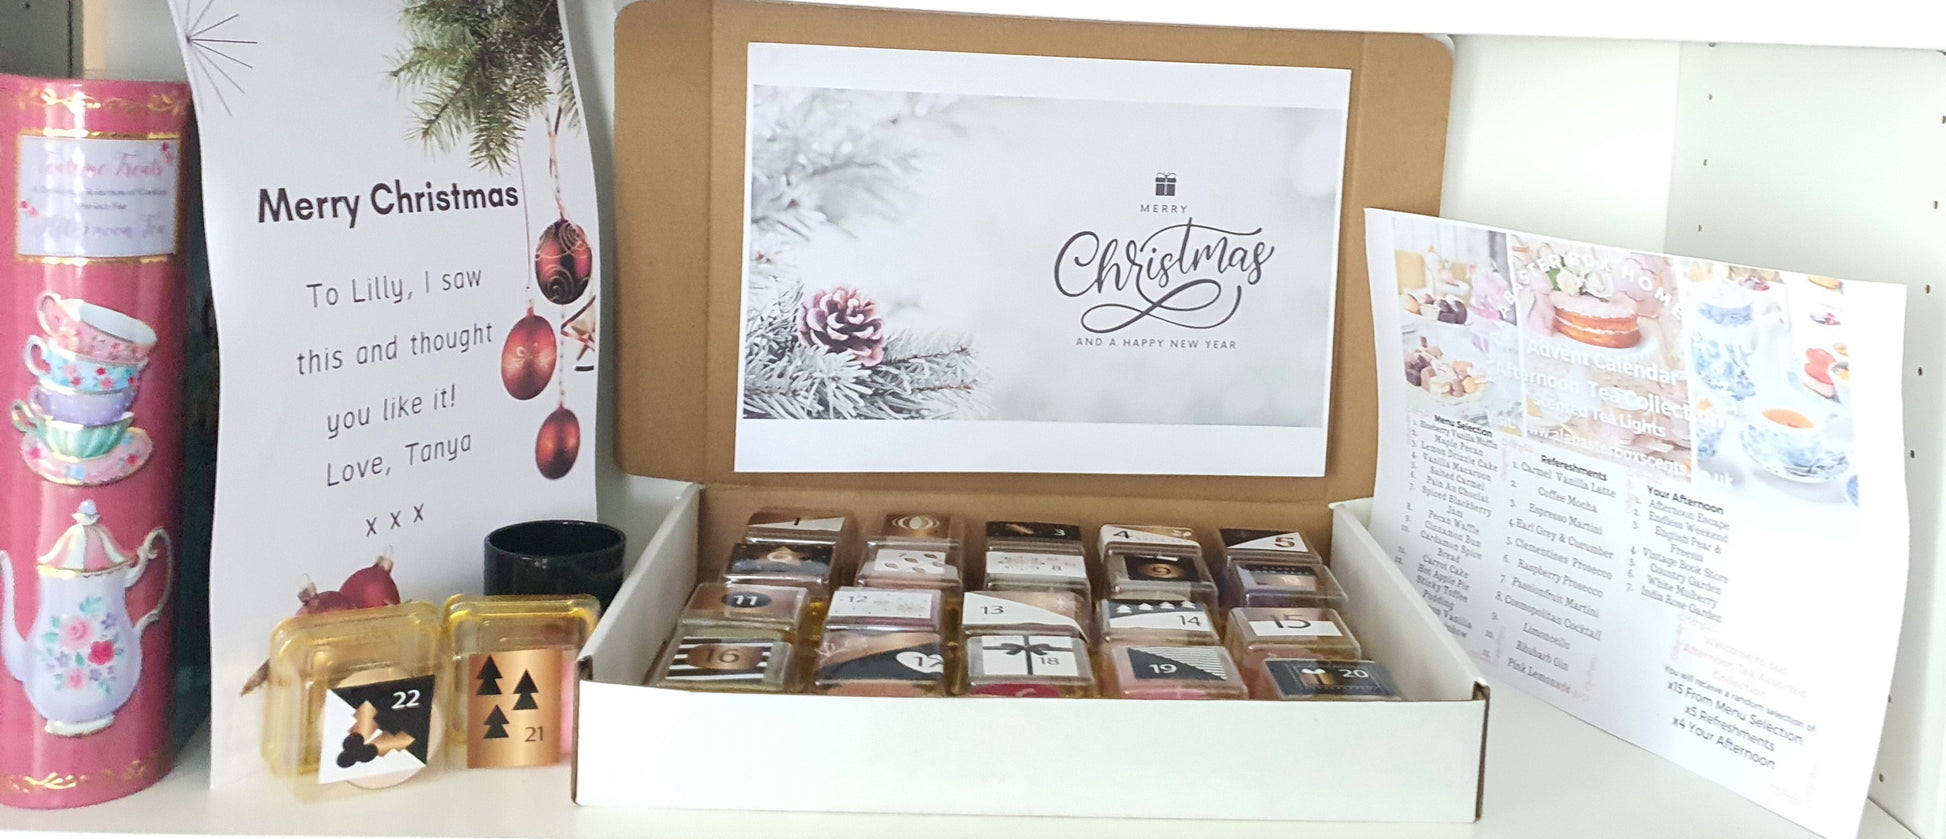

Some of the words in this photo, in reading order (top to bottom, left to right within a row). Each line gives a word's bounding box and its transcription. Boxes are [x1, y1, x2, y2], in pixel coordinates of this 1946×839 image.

[40, 152, 106, 176] Teatme
[258, 188, 360, 229] Merry
[370, 179, 519, 215] Christmas
[1140, 203, 1188, 214] MERRY
[305, 283, 339, 308] To
[352, 275, 413, 304] Lilly,
[424, 271, 430, 294] I
[441, 269, 483, 290] saw
[1054, 217, 1275, 333] Christmas
[1621, 265, 1684, 321] HOME
[297, 349, 344, 375] this
[356, 335, 398, 365] and
[410, 322, 493, 356] thought
[1075, 338, 1103, 347] AND
[1109, 338, 1117, 347] A
[1123, 338, 1164, 348] HAPPY
[1170, 339, 1199, 349] NEW
[1205, 340, 1237, 350] YEAR
[1527, 339, 1590, 367] Advent
[1596, 354, 1677, 386] Calendar
[1498, 363, 1579, 394] Afternoon
[1588, 381, 1618, 402] Tea
[327, 406, 371, 440] you
[383, 394, 423, 422] like
[433, 384, 457, 409] it!
[1592, 408, 1618, 424] Tea
[1620, 413, 1667, 438] Lights
[1434, 414, 1455, 427] Menu
[1457, 421, 1493, 438] Selection
[1421, 440, 1446, 455] Lemon
[1448, 449, 1476, 465] Drizzle
[1477, 459, 1498, 472] Cake
[1434, 434, 1458, 448] Maple
[1460, 442, 1483, 456] Pecan
[326, 456, 392, 487] Love,
[404, 433, 472, 467] Tanya
[1423, 452, 1450, 468] Vanilla
[1430, 466, 1454, 480] Salted
[1427, 475, 1444, 488] Pain
[1445, 483, 1456, 492] Au
[1555, 471, 1589, 490] Vanilla
[1590, 482, 1617, 498] Latte
[1422, 485, 1447, 501] Spiced
[1448, 494, 1492, 518] Blackberry
[1447, 505, 1463, 518] Jam
[1538, 486, 1566, 503] Coffee
[1567, 495, 1598, 513] Mocha
[1647, 485, 1670, 499] Your
[1672, 492, 1724, 515] Afternoon
[1428, 509, 1452, 525] Pecan
[1453, 518, 1479, 535] Waffle
[1528, 502, 1567, 524] Espresso
[1568, 515, 1603, 536] Martini
[1649, 498, 1695, 520] Afternoon
[1697, 512, 1730, 531] Escape
[1649, 510, 1683, 529] Endless
[1686, 521, 1729, 543] Weekend
[1054, 528, 1065, 536] 3
[1113, 530, 1133, 539] 4
[1274, 537, 1296, 548] 5
[1425, 520, 1463, 541] Cinnamon
[1465, 534, 1481, 548] Bun
[1516, 518, 1534, 533] Earl
[1536, 525, 1557, 542] Grey
[1568, 536, 1614, 559] Cucumber
[1655, 526, 1689, 544] English
[1691, 537, 1712, 551] Pear
[1437, 547, 1460, 563] Bread
[1461, 545, 1482, 560] Spice
[1515, 537, 1569, 564] Clementines
[1572, 557, 1613, 580] Prosecco
[1643, 547, 1677, 567] Vintage
[1679, 559, 1702, 575] Book
[1704, 568, 1729, 584] Store
[1670, 543, 1704, 562] Freesia
[1051, 564, 1062, 572] 8
[1156, 565, 1172, 575] 9
[1417, 563, 1432, 576] Hot
[1432, 570, 1456, 585] Apple
[1458, 579, 1470, 591] Pie
[1423, 554, 1447, 570] Carrot
[1449, 564, 1469, 579] Cake
[1517, 558, 1562, 584] Raspberry
[1562, 574, 1604, 598] Prosecco
[1650, 563, 1686, 585] Country
[1688, 576, 1722, 595] Garden
[733, 595, 757, 606] 11
[849, 595, 868, 603] 12
[1416, 574, 1442, 593] Sticky
[1444, 585, 1468, 602] Toffee
[1422, 589, 1455, 611] Pudding
[1648, 574, 1674, 592] White
[1676, 585, 1718, 609] Mulberry
[980, 605, 1004, 615] 13
[1504, 594, 1562, 625] Cosmopolitan
[1564, 618, 1601, 641] Cocktail
[1564, 596, 1600, 618] Martini
[1641, 585, 1664, 602] India
[1665, 594, 1687, 610] Rose
[1688, 603, 1722, 623] Garden
[1178, 615, 1202, 627] 14
[1269, 614, 1311, 630] 15
[1443, 609, 1472, 630] Vanilla
[1522, 622, 1570, 649] Limoncello
[706, 648, 740, 663] 16
[1038, 656, 1060, 666] 18
[1149, 663, 1177, 674] 19
[1515, 640, 1552, 663] Rhubarb
[1553, 657, 1568, 672] Gin
[1339, 668, 1369, 678] 20
[1507, 657, 1526, 673] Pink
[1528, 666, 1571, 694] Lemonade
[392, 690, 421, 710] 22
[1664, 665, 1680, 677] You
[1680, 671, 1694, 682] will
[1695, 678, 1723, 694] receive
[1731, 693, 1765, 711] random
[1766, 706, 1805, 728] selection
[1806, 724, 1816, 733] of
[1667, 681, 1684, 694] x15
[1685, 688, 1714, 707] From
[1715, 699, 1746, 721] Menu
[1749, 713, 1803, 745] Selection
[525, 726, 544, 742] 21
[1684, 706, 1698, 717] x5
[1699, 710, 1775, 752] Refreshments
[1672, 717, 1686, 729] x4
[1688, 721, 1715, 742] Your
[1716, 735, 1776, 770] Afternoon
